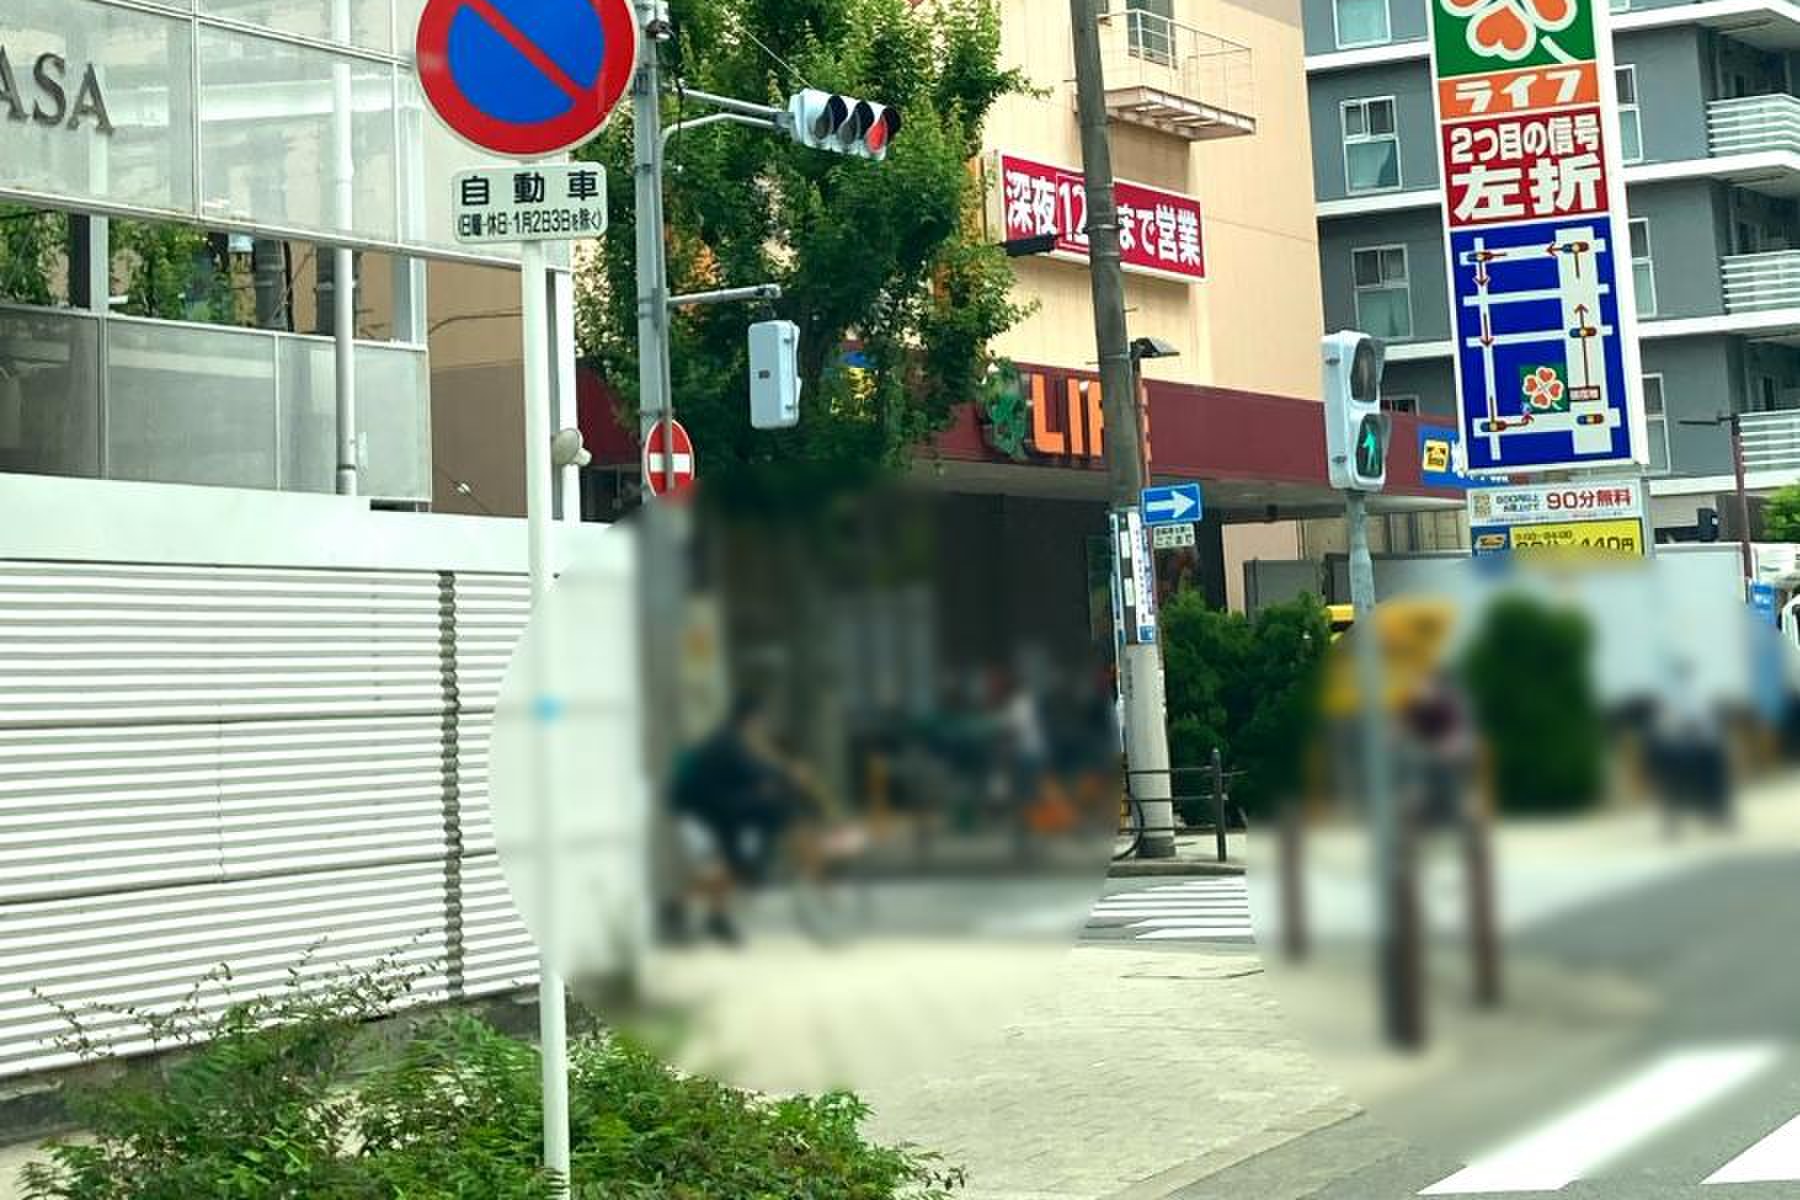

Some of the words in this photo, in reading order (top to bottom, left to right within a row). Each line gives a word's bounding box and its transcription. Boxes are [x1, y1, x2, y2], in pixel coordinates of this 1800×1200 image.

[1454, 69, 1582, 113] ライフ
[1450, 113, 1600, 164] 2つ目の信号
[1451, 154, 1602, 221] 左折
[1006, 170, 1201, 266] 深夜12まで営業
[1546, 488, 1632, 511] 90分無料
